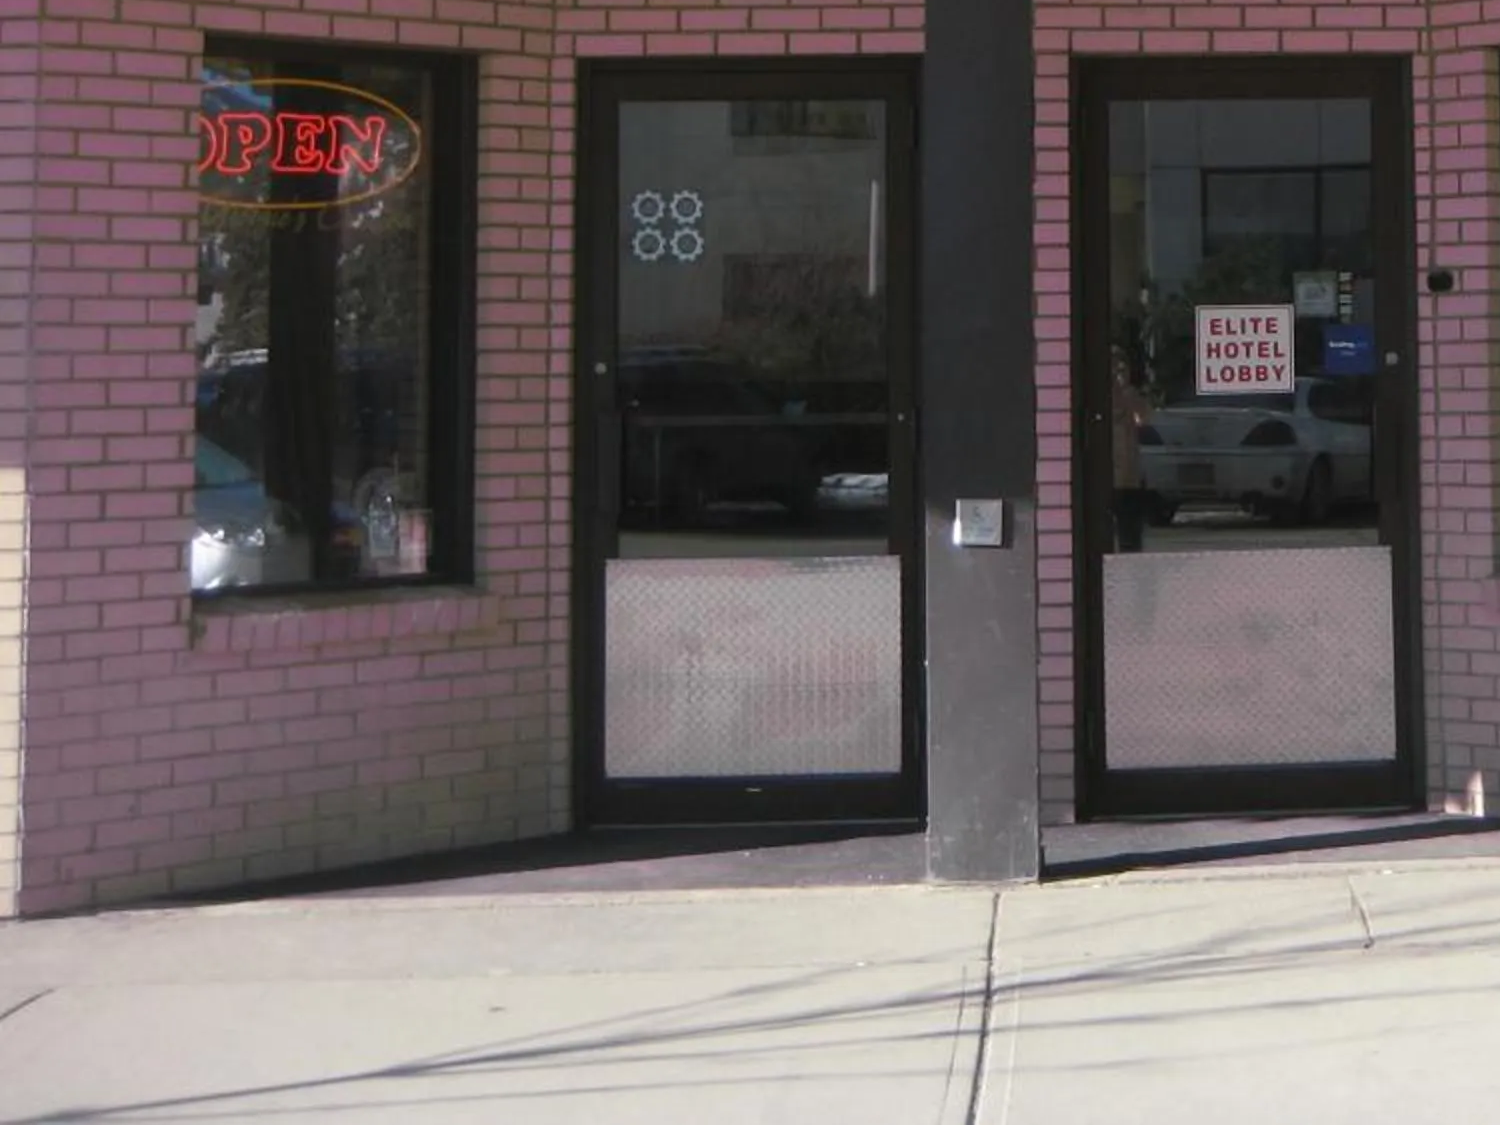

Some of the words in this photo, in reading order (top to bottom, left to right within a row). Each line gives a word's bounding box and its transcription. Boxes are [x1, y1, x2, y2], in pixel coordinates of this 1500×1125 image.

[1209, 316, 1279, 336] ELITE
[1206, 340, 1286, 360] HOTEL
[1205, 364, 1287, 384] LOBBY
